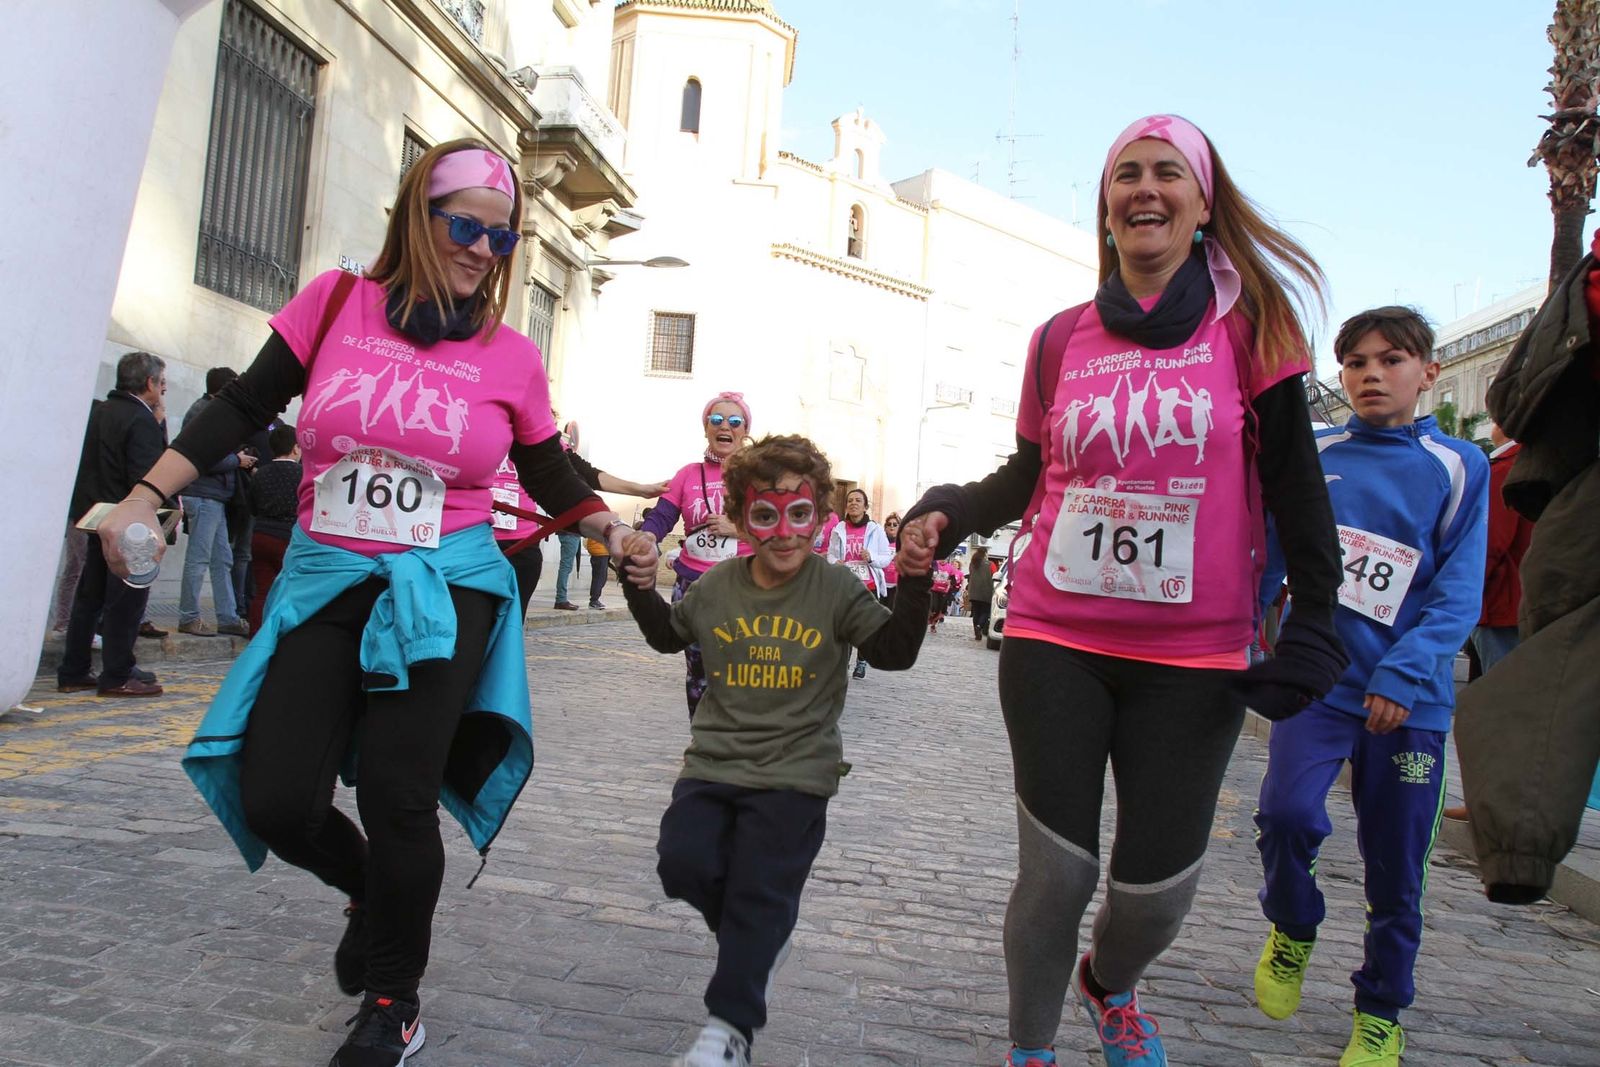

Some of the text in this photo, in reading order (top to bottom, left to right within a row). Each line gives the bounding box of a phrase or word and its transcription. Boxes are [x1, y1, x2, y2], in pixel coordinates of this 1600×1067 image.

[342, 335, 356, 345] DE
[357, 339, 370, 352] LA
[373, 347, 413, 363] MUJER
[424, 359, 481, 383] RUNNING
[365, 336, 481, 376] CARRERA PINK
[1064, 353, 1213, 381] DE LA MUJER & RUNNING
[1086, 342, 1211, 369] CARRERA PINK
[351, 454, 382, 468] MUJER
[342, 468, 422, 513] 160
[1068, 503, 1077, 513] DE
[1078, 504, 1089, 513] LA
[1138, 511, 1190, 524] RUNNING
[1083, 494, 1126, 508] CARRERA
[1164, 502, 1190, 513] PINK
[696, 533, 729, 549] 637
[1083, 522, 1164, 567] 161
[1373, 546, 1413, 567] RUNNING
[1395, 547, 1416, 561] PINK
[1340, 547, 1393, 592] 48
[713, 615, 822, 649] NACIDO
[749, 645, 781, 661] PARA
[727, 663, 803, 688] LUCHAR
[1392, 752, 1436, 767] NEW YORK
[1407, 762, 1424, 777] 98
